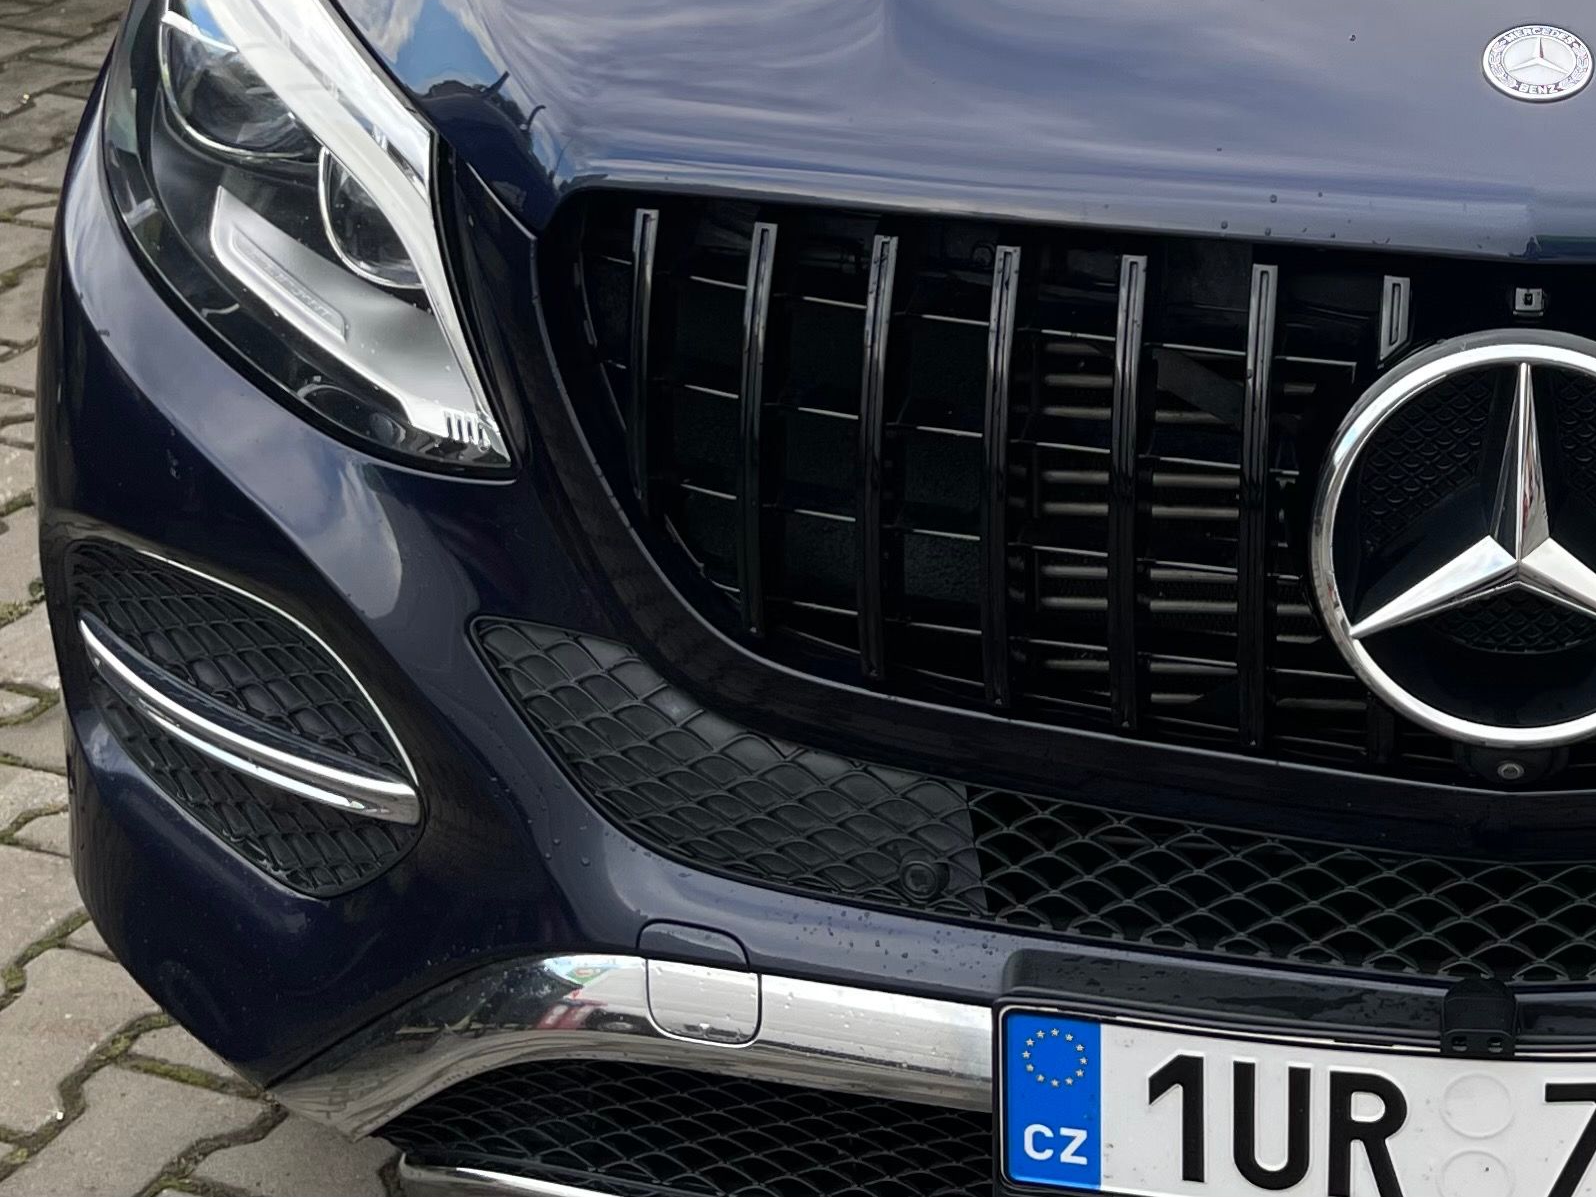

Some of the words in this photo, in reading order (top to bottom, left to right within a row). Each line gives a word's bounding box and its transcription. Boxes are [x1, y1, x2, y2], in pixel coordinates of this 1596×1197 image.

[1504, 27, 1576, 45] MERCEDES
[1518, 84, 1559, 95] BENZ
[1148, 1054, 1408, 1197] 1UR
[1023, 1123, 1089, 1166] CZ
